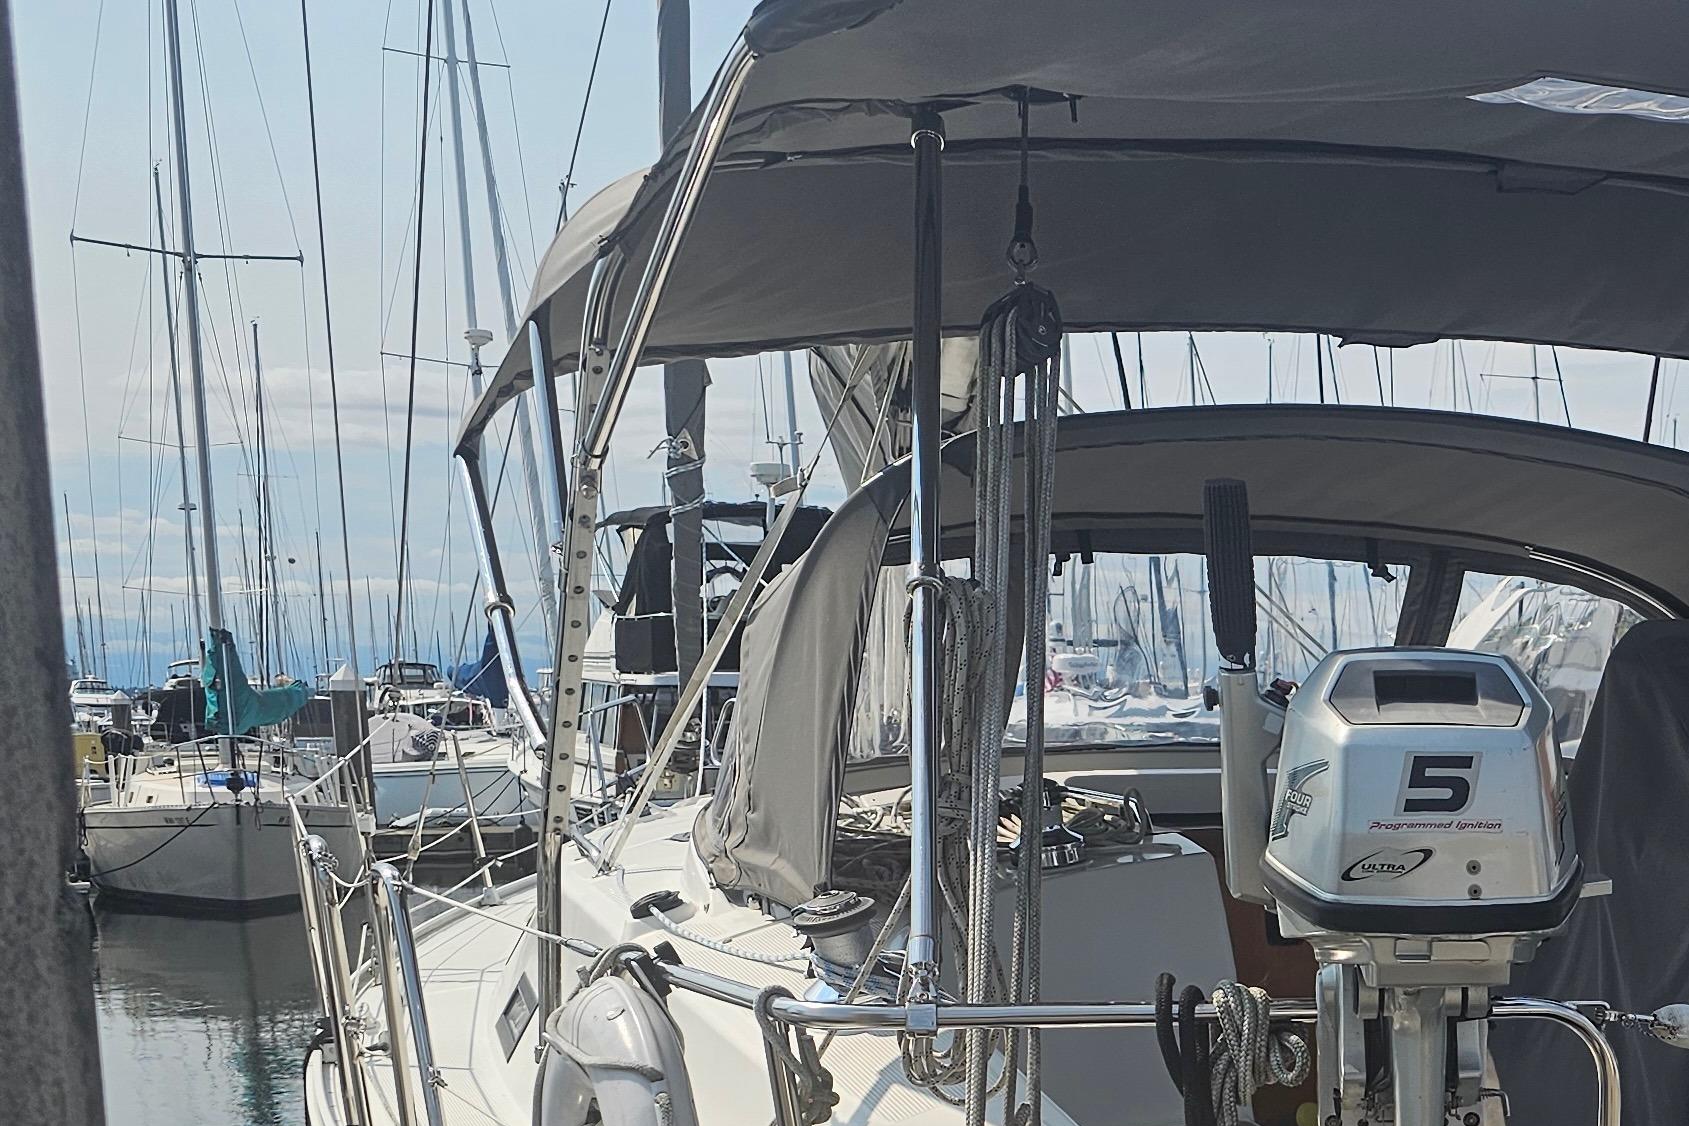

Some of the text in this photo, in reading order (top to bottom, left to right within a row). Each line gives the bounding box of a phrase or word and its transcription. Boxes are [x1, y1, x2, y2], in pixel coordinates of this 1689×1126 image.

[1402, 755, 1475, 813] 5
[1285, 788, 1312, 807] FOUR
[1369, 820, 1502, 831] Programmed Ignition
[1361, 863, 1406, 871] ULTRA
